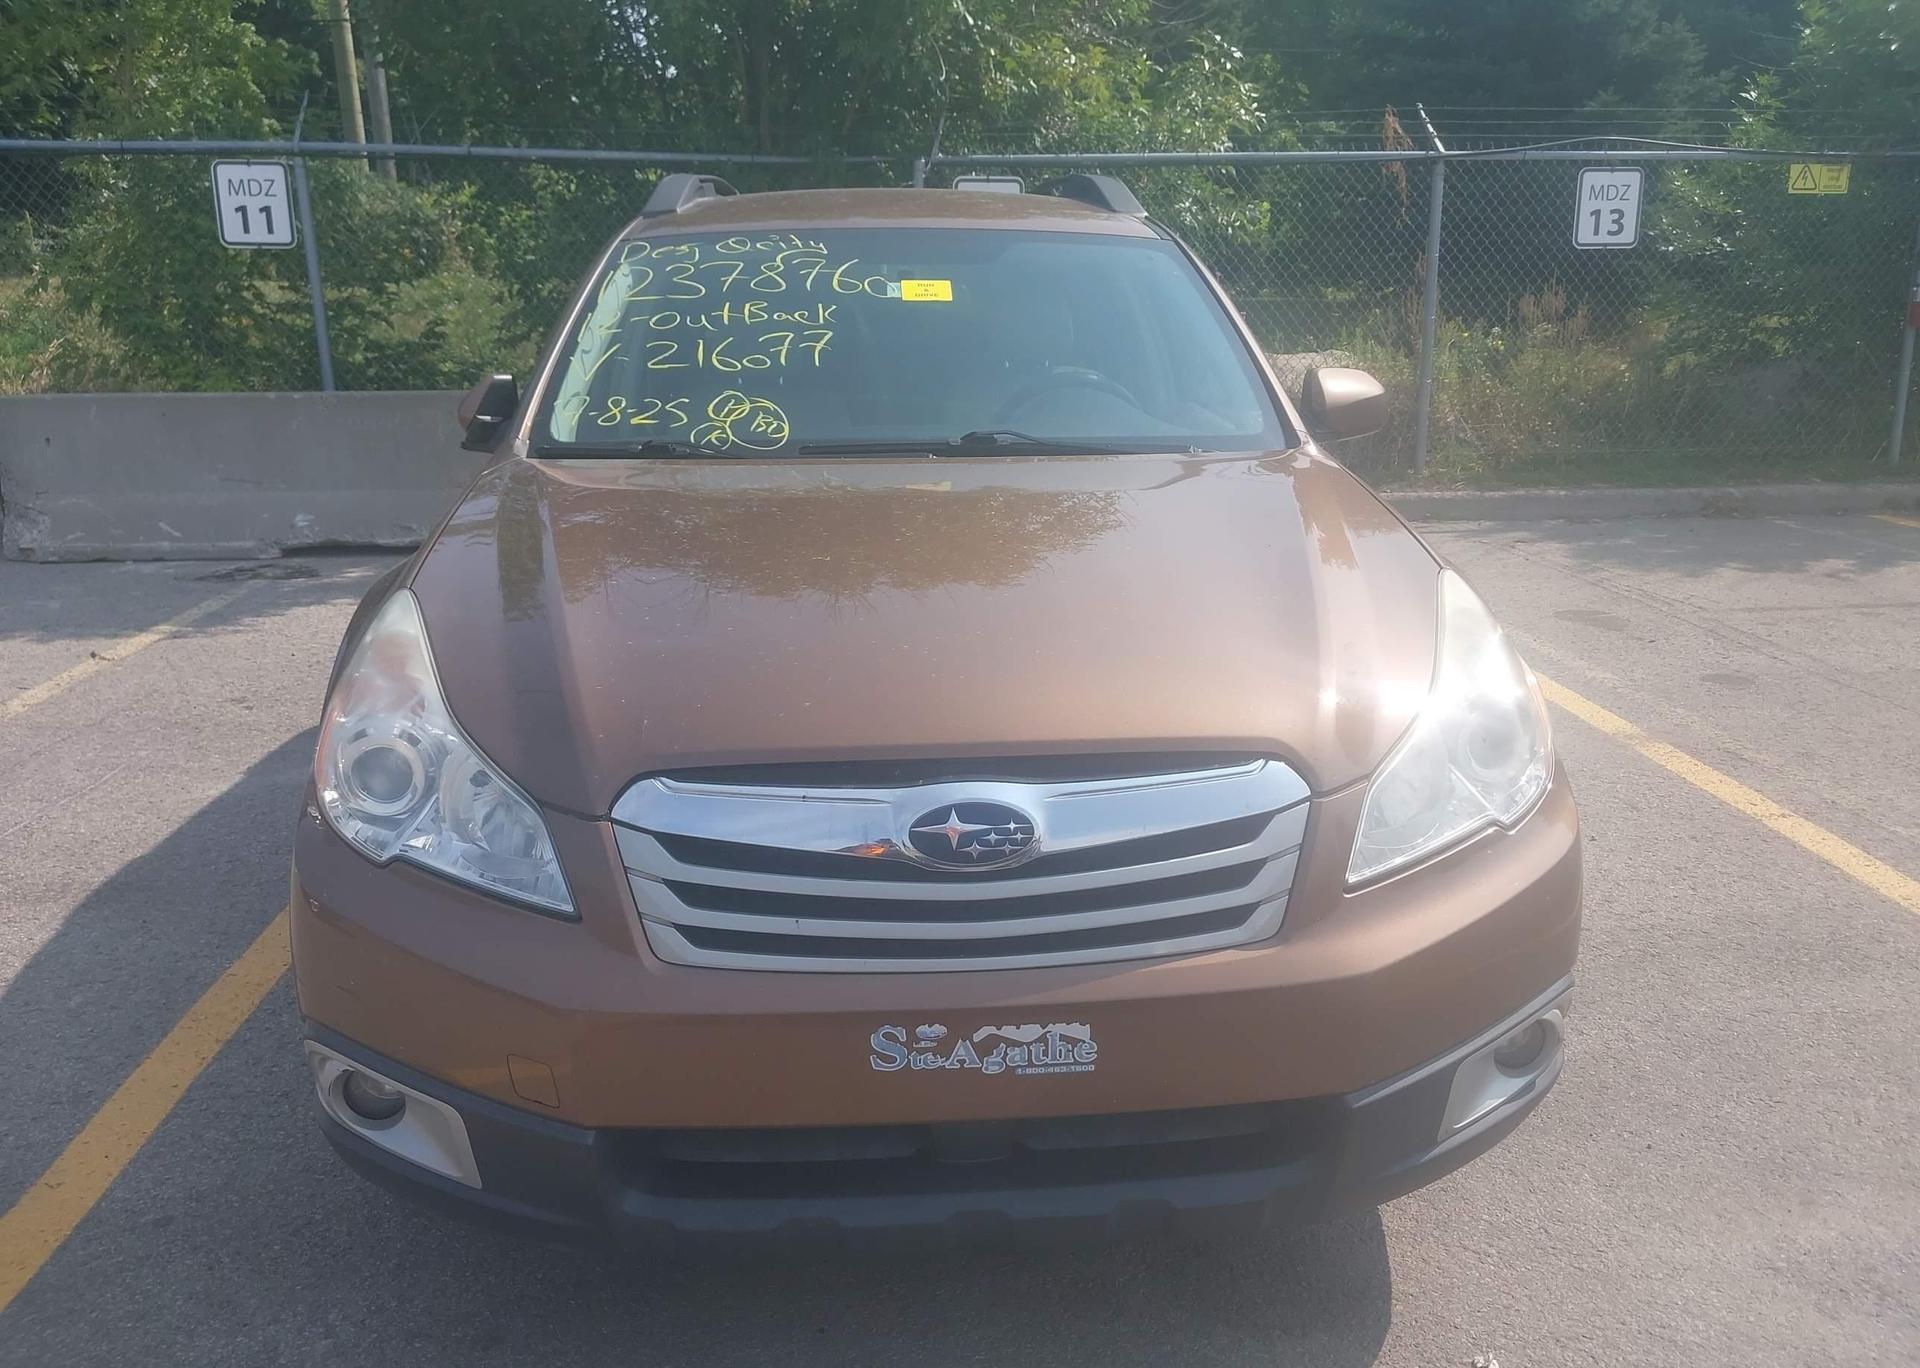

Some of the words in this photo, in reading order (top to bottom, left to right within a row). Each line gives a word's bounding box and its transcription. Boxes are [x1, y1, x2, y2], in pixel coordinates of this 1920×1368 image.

[228, 178, 278, 198] MDZ
[1588, 184, 1632, 202] MDZ
[234, 204, 275, 235] 11
[1589, 208, 1625, 237] 13
